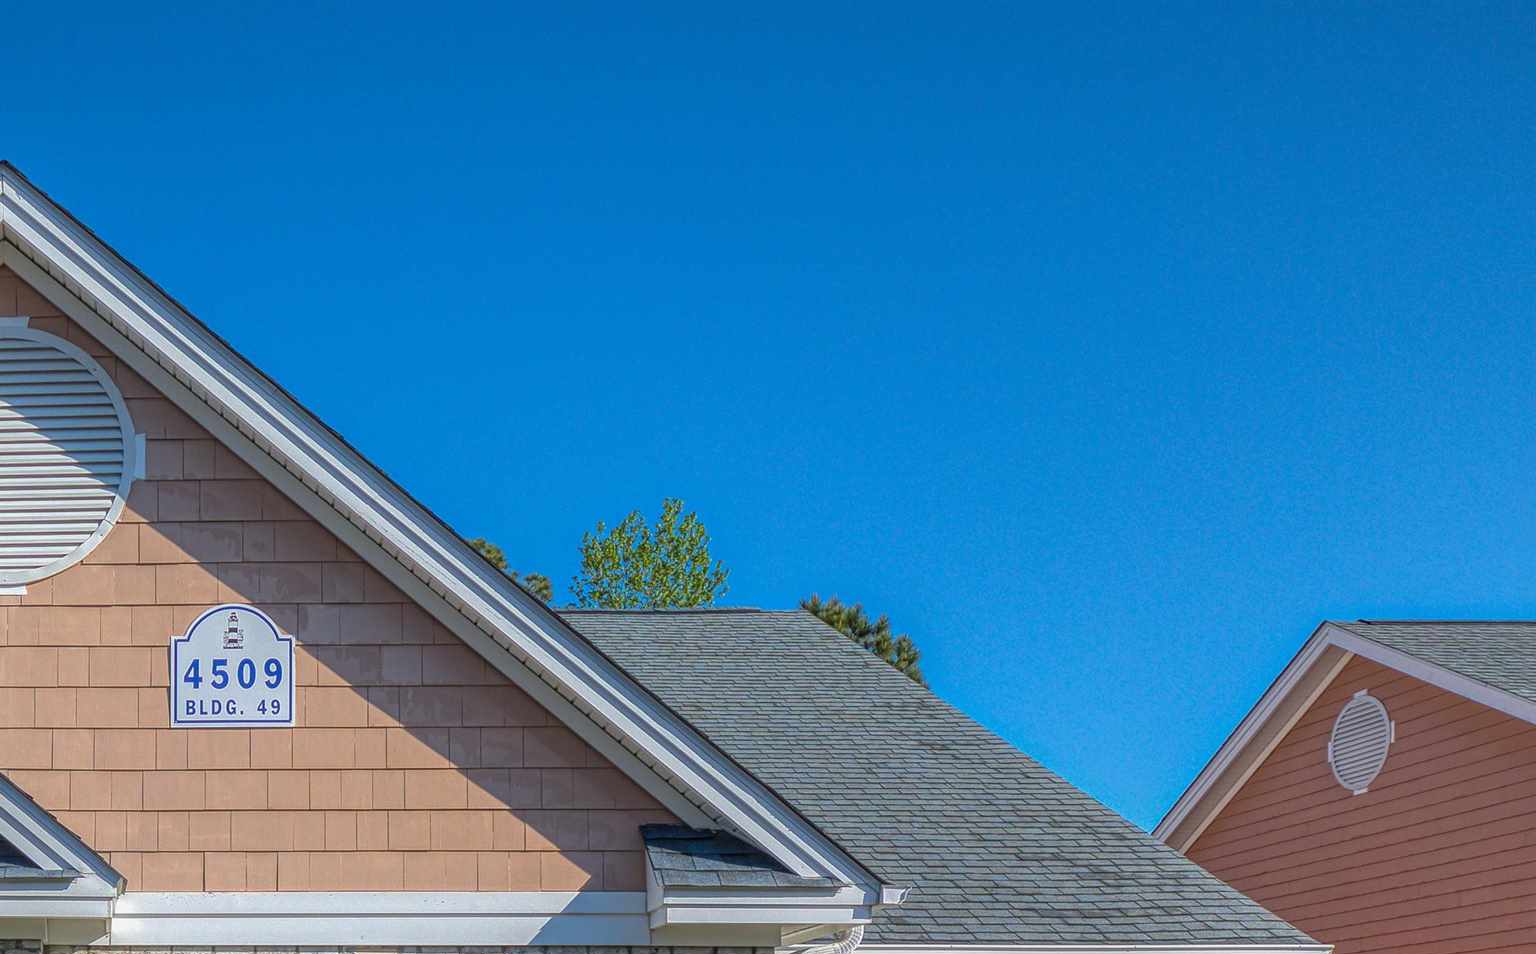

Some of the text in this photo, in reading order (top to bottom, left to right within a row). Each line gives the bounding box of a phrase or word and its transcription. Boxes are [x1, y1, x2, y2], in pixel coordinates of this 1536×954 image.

[184, 658, 283, 689] 4509
[185, 699, 281, 715] BLDG. 49
